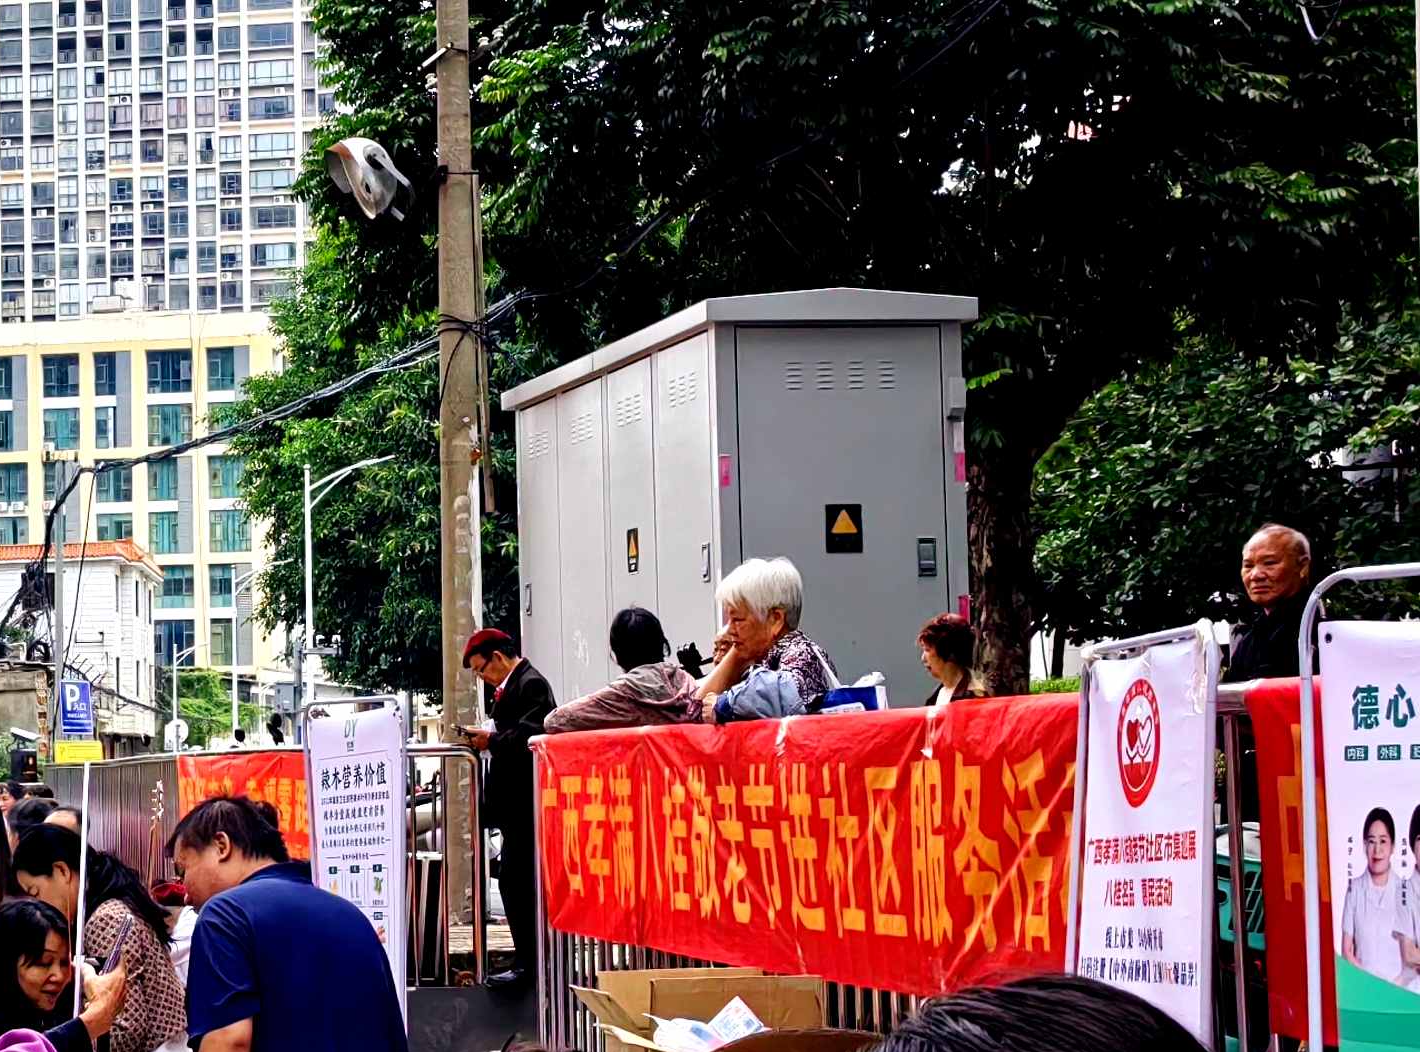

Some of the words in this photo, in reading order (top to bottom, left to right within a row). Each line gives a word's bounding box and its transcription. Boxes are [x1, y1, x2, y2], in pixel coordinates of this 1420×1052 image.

[65, 684, 80, 711] P
[1352, 684, 1416, 730] 德心
[541, 748, 1076, 954] 广西孝满八桂敬老节进社区服务活
